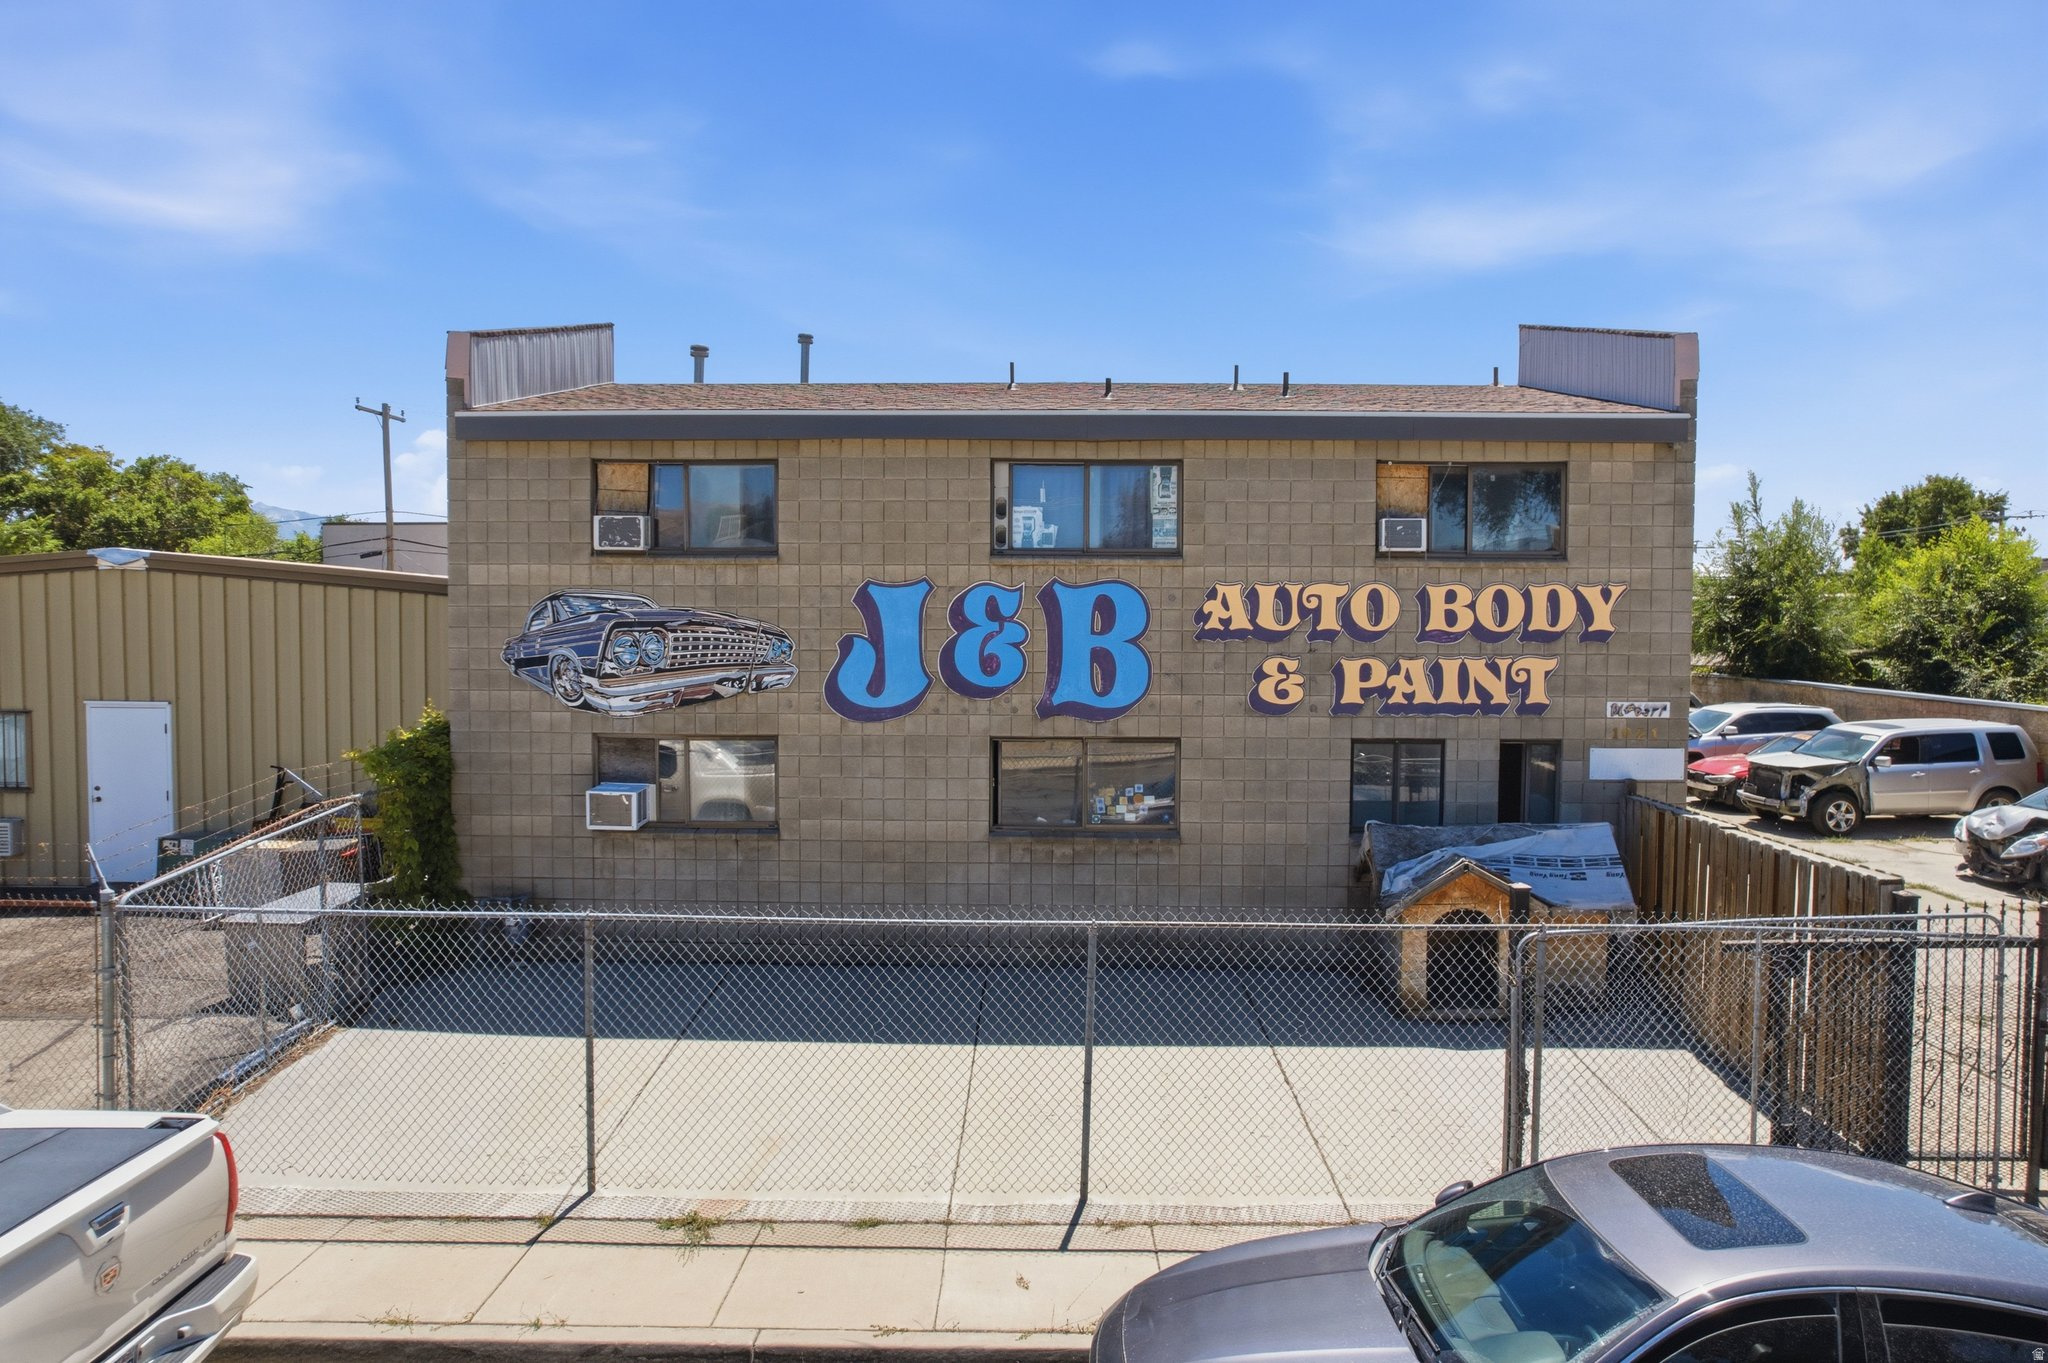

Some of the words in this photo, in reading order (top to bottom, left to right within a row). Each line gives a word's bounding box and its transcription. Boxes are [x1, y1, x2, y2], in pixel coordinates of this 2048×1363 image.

[1194, 582, 1401, 643] AUTO
[1415, 582, 1629, 643] BODY
[1249, 655, 1305, 715] &
[1330, 655, 1559, 716] PAINT
